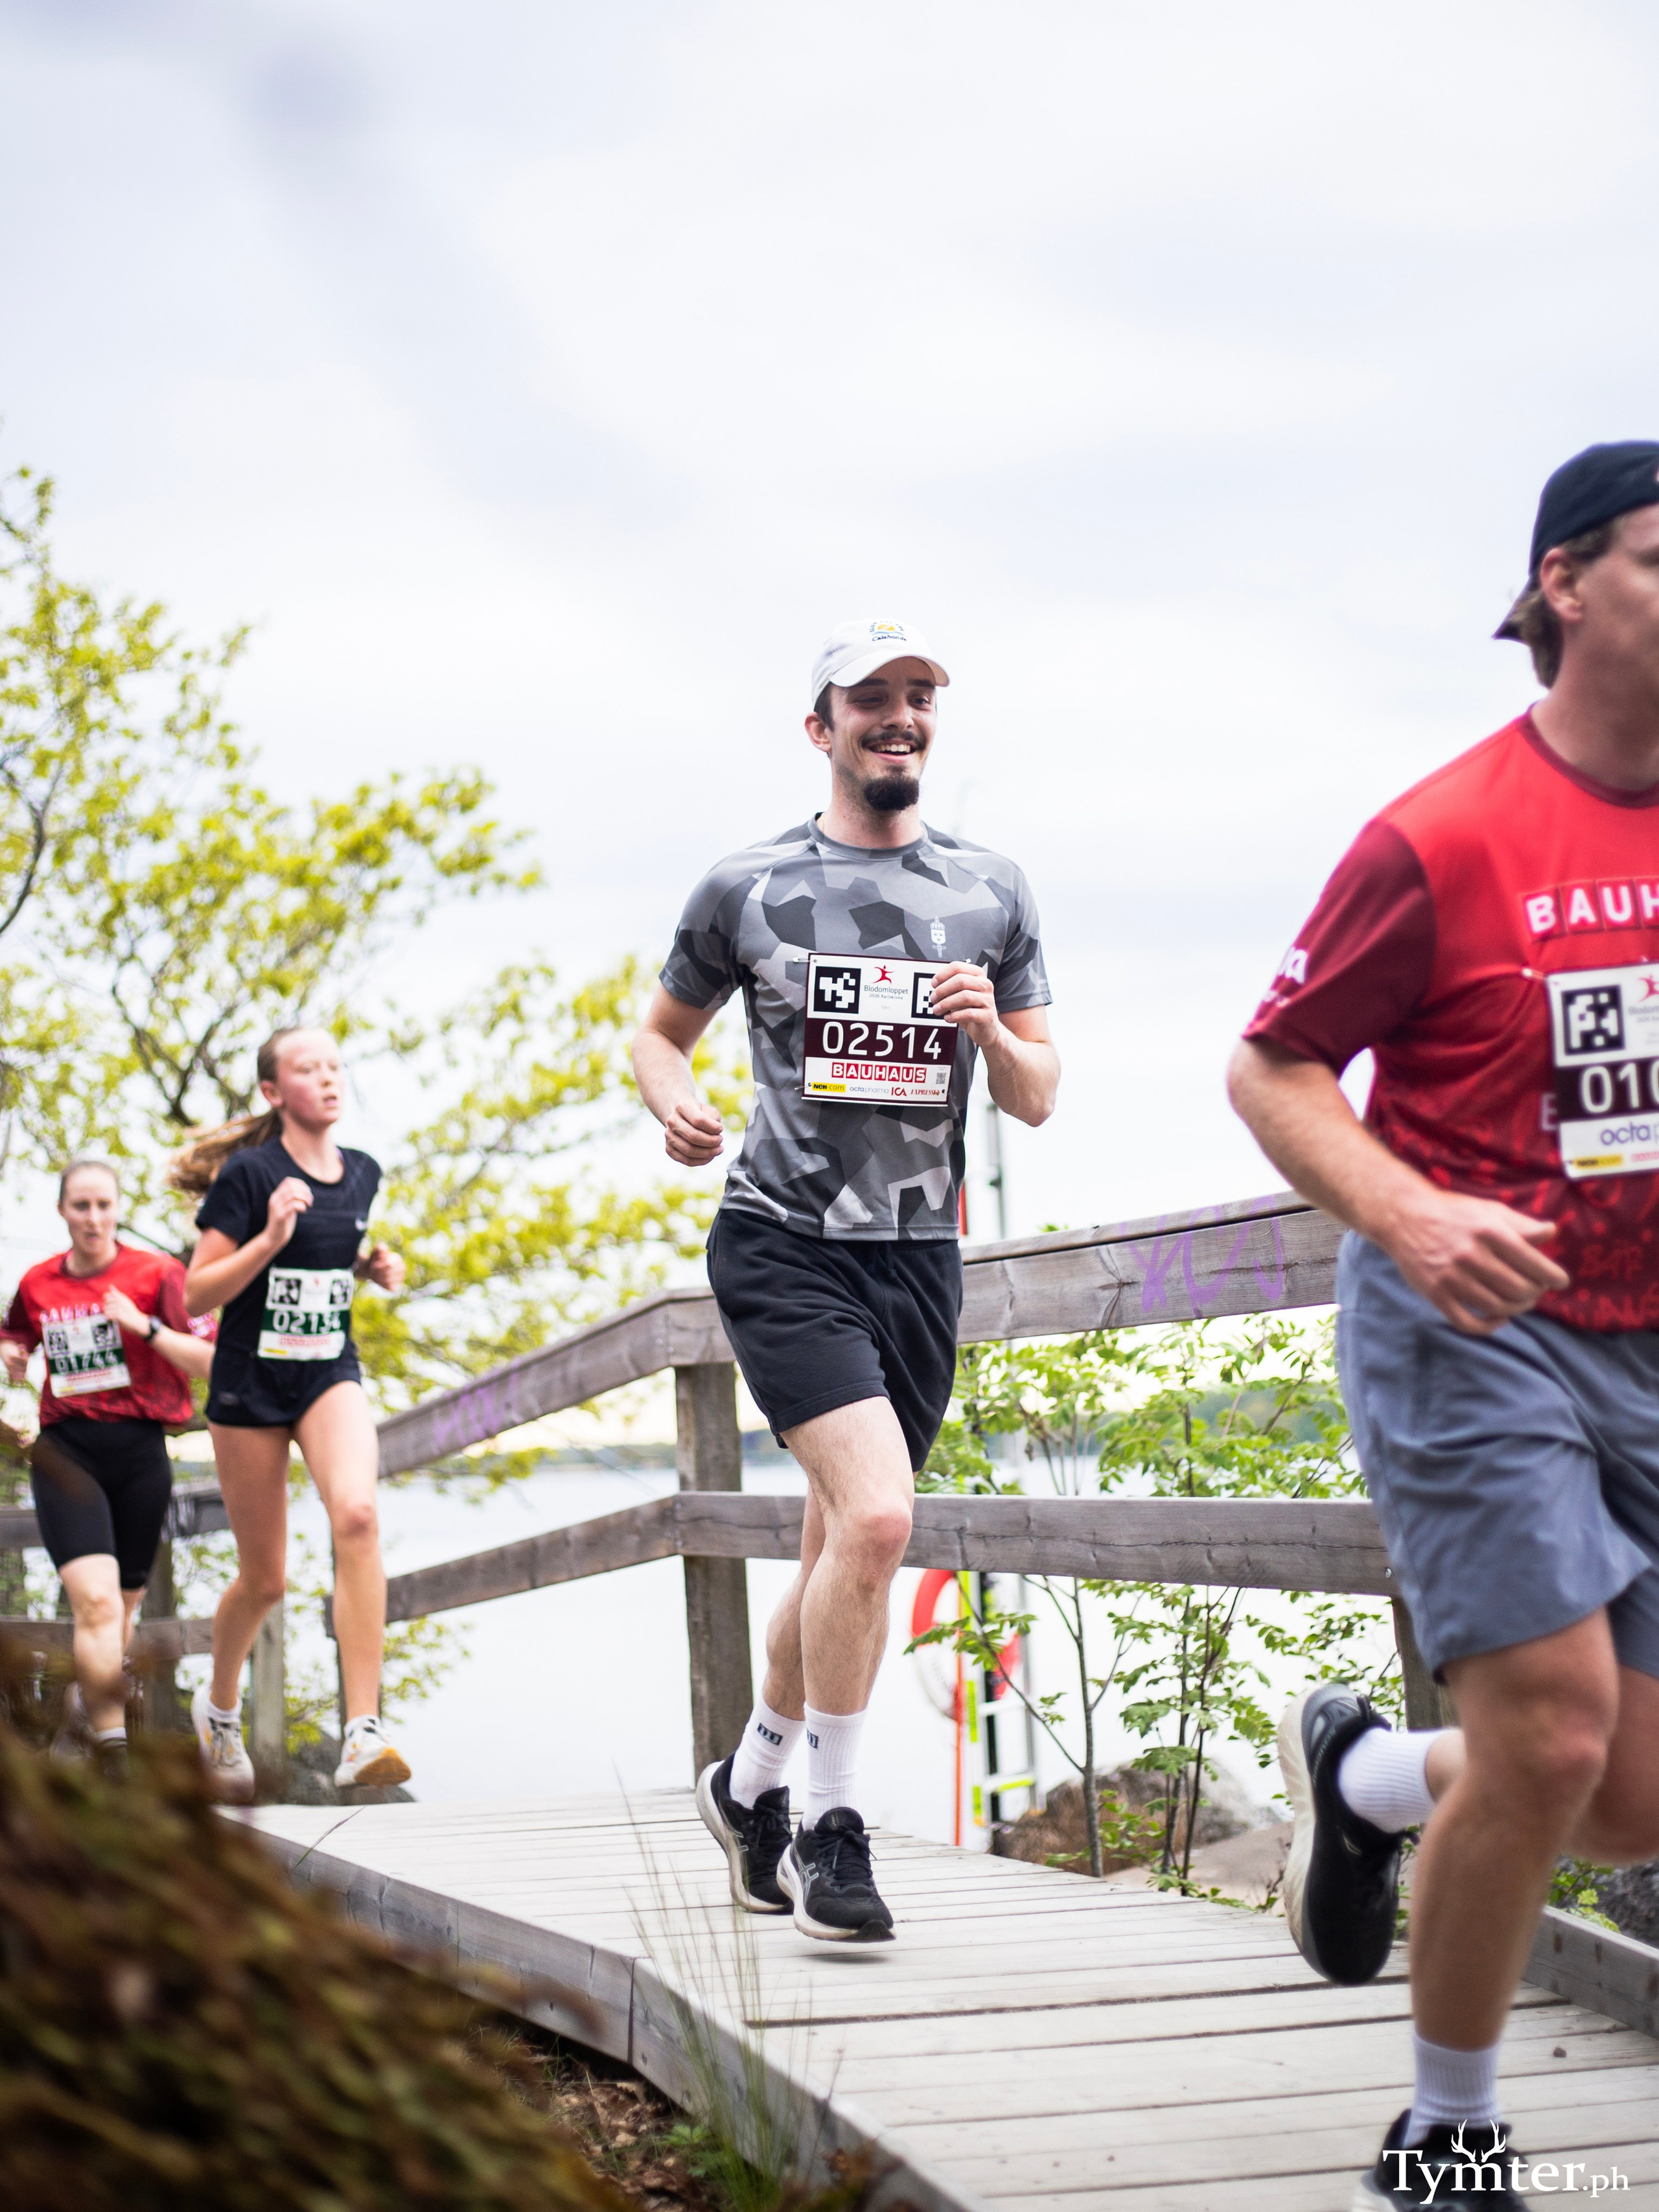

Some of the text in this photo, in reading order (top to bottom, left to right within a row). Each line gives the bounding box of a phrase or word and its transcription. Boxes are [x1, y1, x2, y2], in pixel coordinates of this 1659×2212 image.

[1527, 884, 1659, 933] BAUH
[864, 984, 908, 995] Blodomloppet
[822, 1021, 941, 1060] 02514
[832, 1064, 926, 1082] BAUHAUS
[1581, 1061, 1659, 1113] 01
[850, 1086, 888, 1094] octapharma
[891, 1086, 907, 1097] ICA
